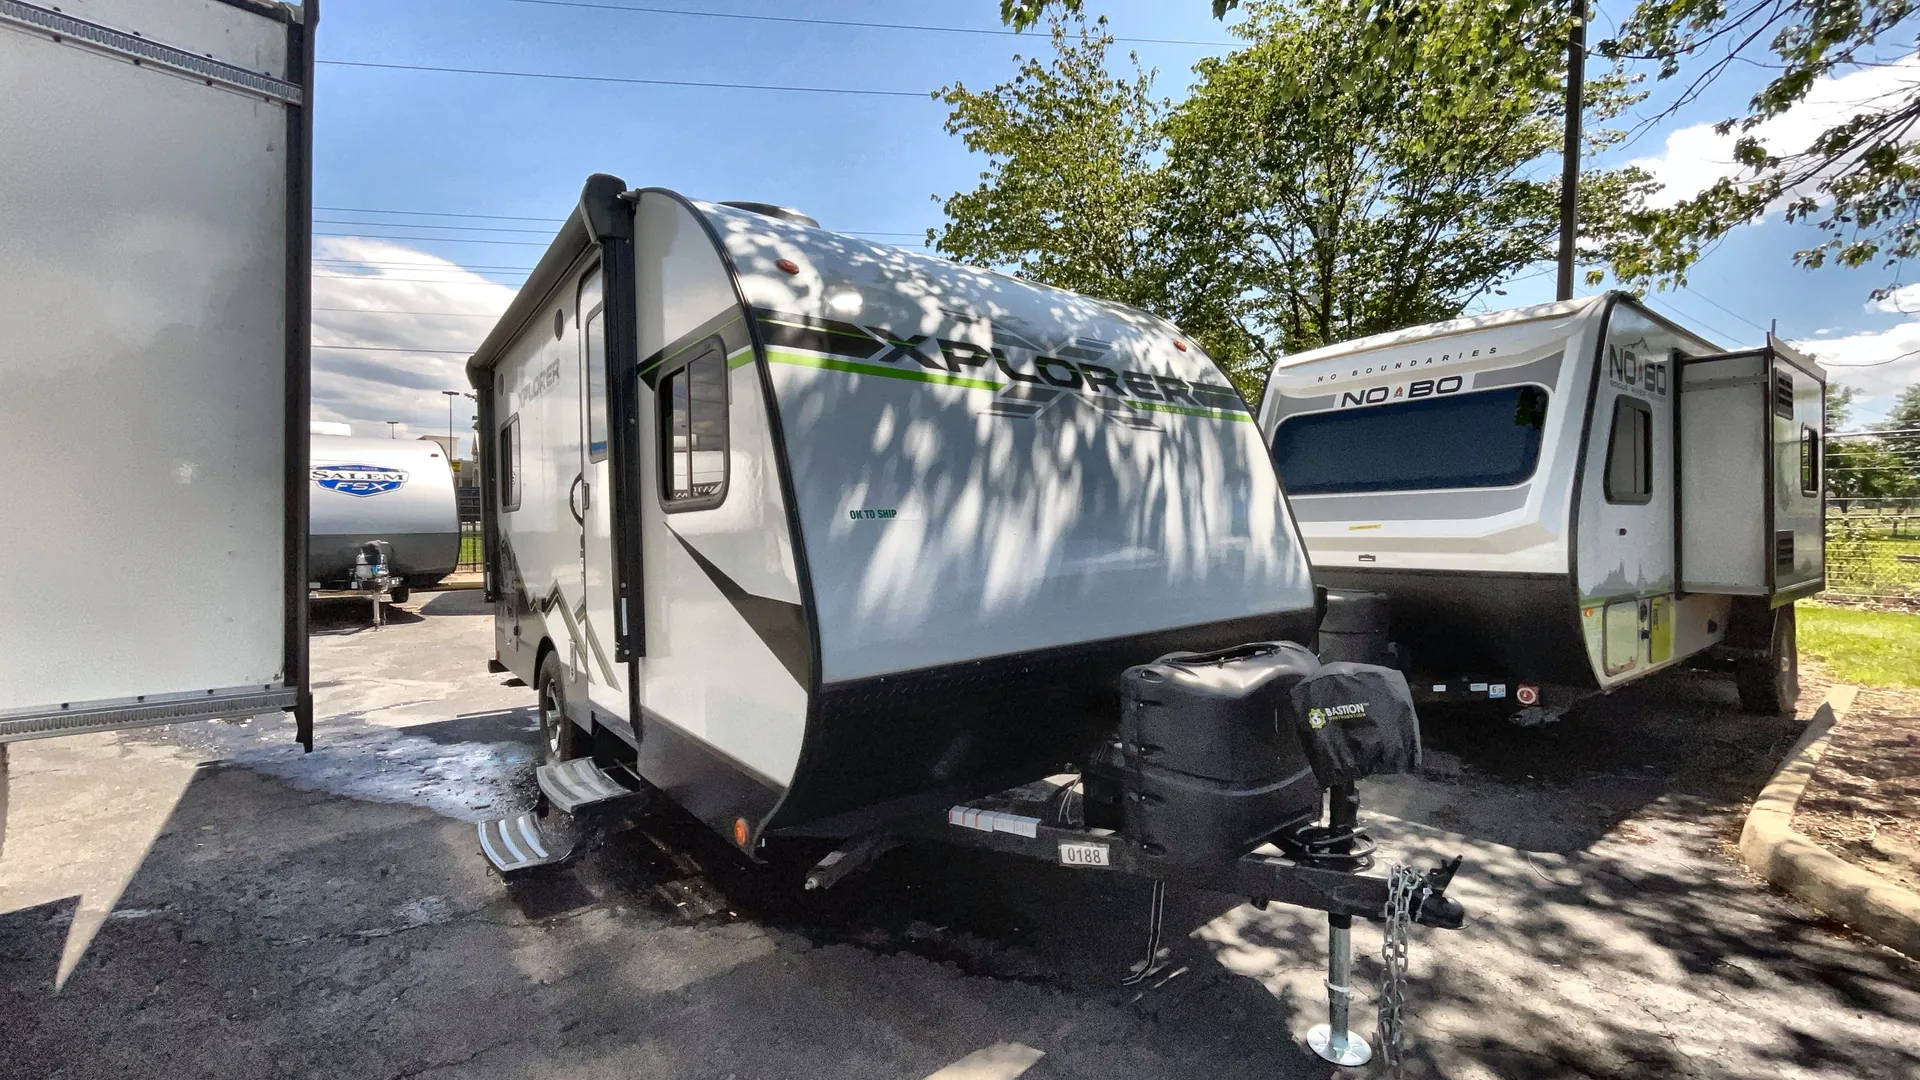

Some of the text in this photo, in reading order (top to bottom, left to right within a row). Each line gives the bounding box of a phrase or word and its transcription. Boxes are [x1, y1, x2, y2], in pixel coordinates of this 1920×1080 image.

[862, 325, 1204, 408] XPLORER
[1317, 347, 1497, 382] NO BOUNDARIES
[1609, 343, 1636, 386] NO
[1644, 359, 1667, 396] BO
[1341, 375, 1463, 407] NO BO
[312, 470, 404, 481] SALEM
[334, 482, 390, 491] FSX
[850, 509, 897, 520] OK TO SHIP
[1324, 703, 1365, 717] BASTION
[1067, 847, 1101, 864] 0188
